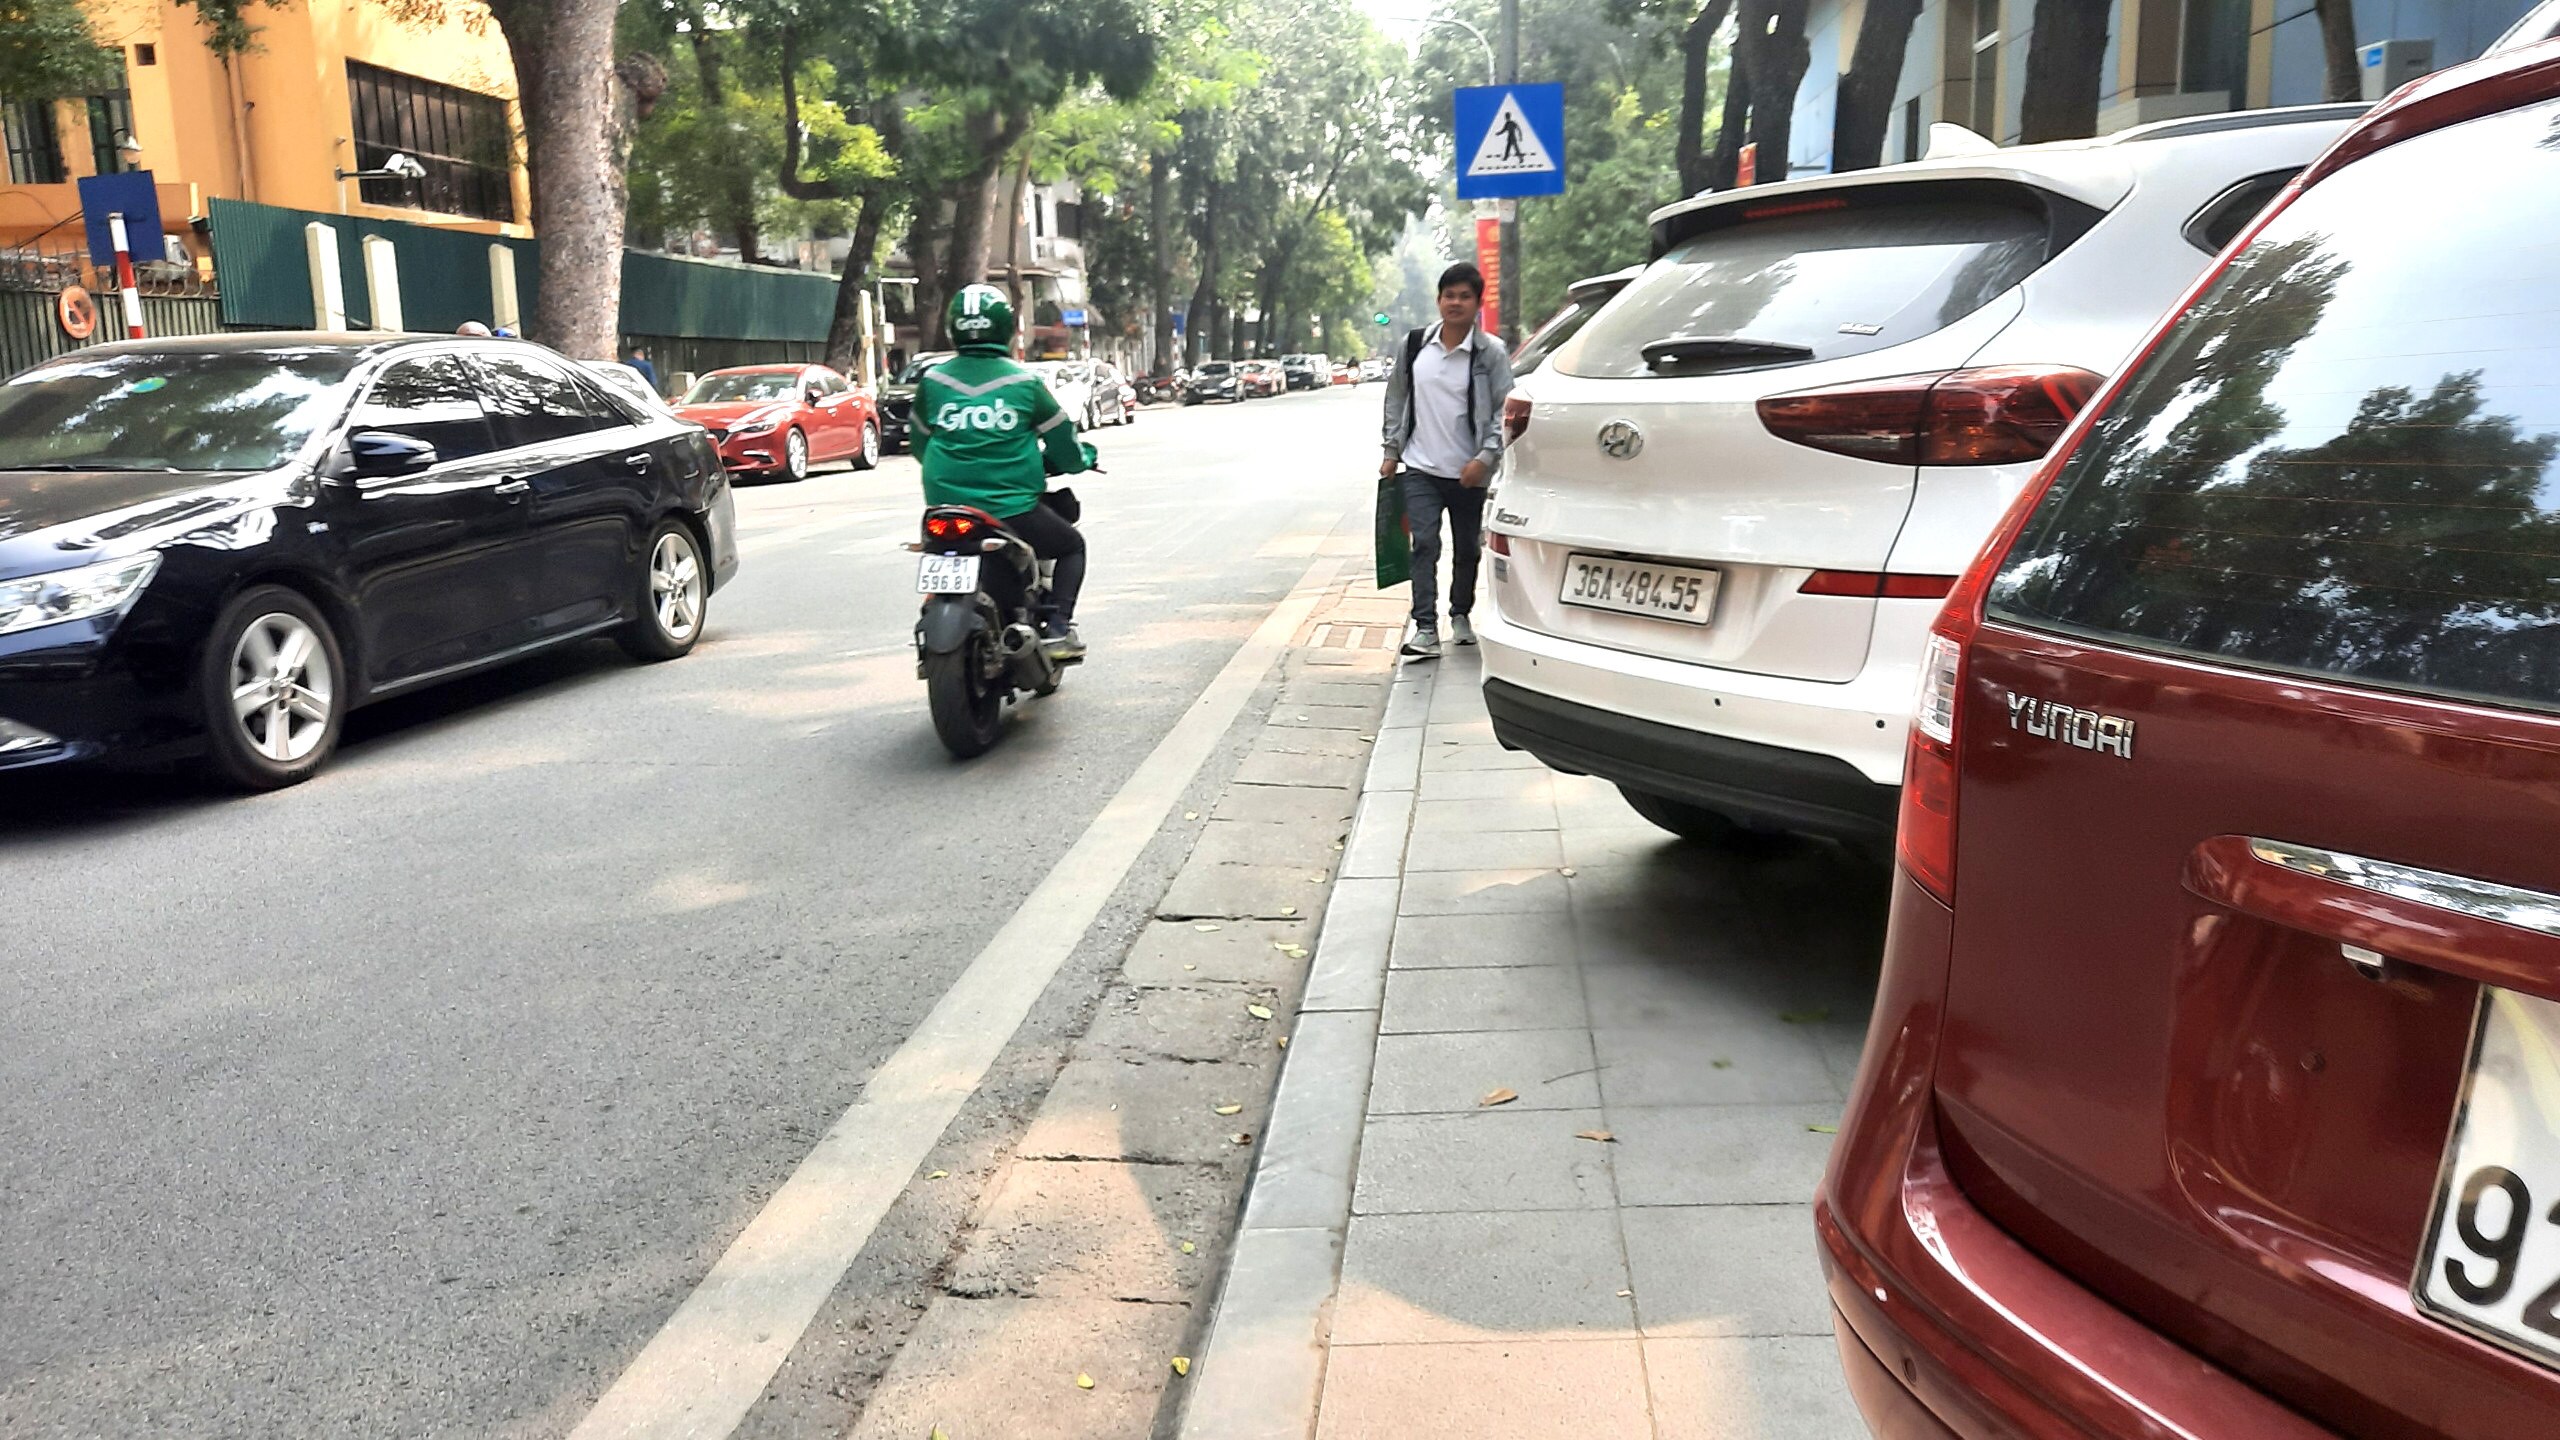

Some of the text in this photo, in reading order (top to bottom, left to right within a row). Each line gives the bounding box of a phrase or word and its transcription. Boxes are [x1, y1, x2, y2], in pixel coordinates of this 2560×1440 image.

[955, 315, 992, 331] Grab
[937, 398, 1018, 431] Grab
[2006, 690, 2135, 760] YUNDAI
